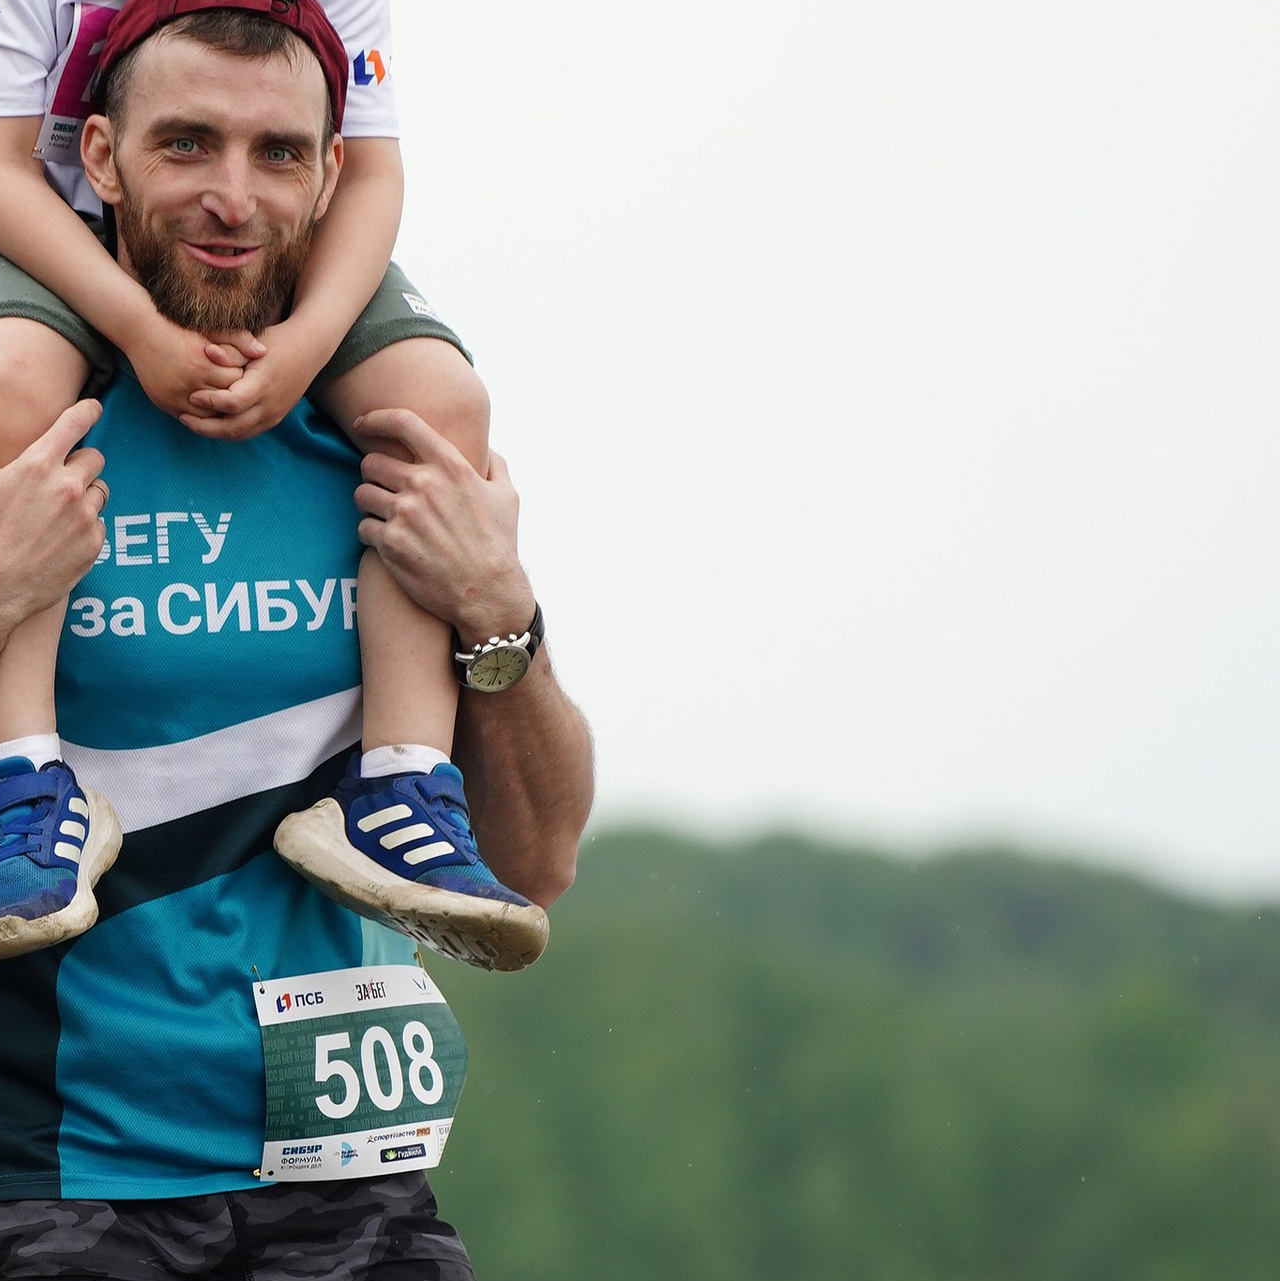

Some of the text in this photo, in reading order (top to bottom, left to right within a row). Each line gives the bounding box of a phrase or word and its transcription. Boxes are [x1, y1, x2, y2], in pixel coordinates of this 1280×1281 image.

[70, 596, 147, 638] за
[295, 991, 324, 1008] ПСБ
[314, 1020, 444, 1120] 508
[282, 1144, 322, 1155] СИБУР
[281, 1156, 322, 1164] ФОРМУЛА
